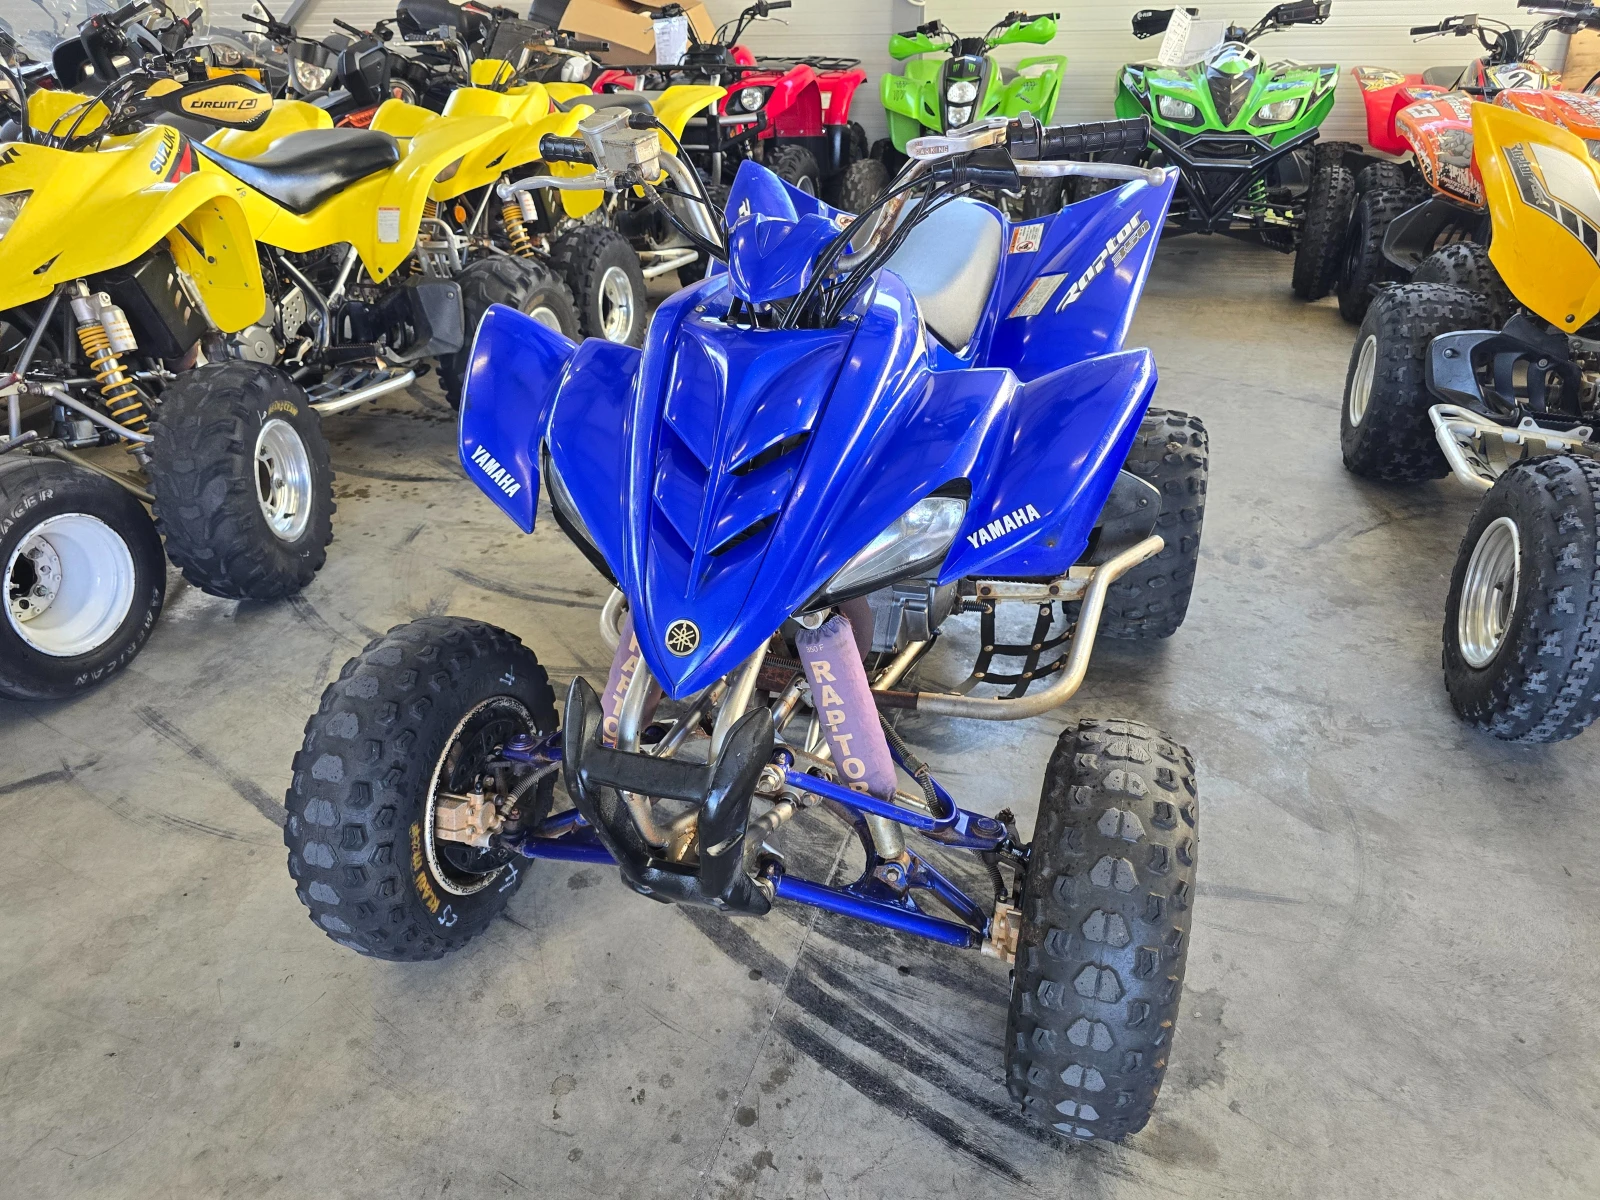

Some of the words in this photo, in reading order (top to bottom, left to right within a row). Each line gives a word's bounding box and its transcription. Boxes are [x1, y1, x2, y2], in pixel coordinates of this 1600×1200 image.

[190, 101, 239, 109] CIRCUIT
[149, 126, 177, 176] SUZUKI
[1054, 209, 1143, 315] Raptor
[1111, 220, 1151, 268] 350
[471, 444, 521, 498] YAMAHA
[0, 488, 54, 544] ACER
[966, 503, 1041, 549] YAMAHA
